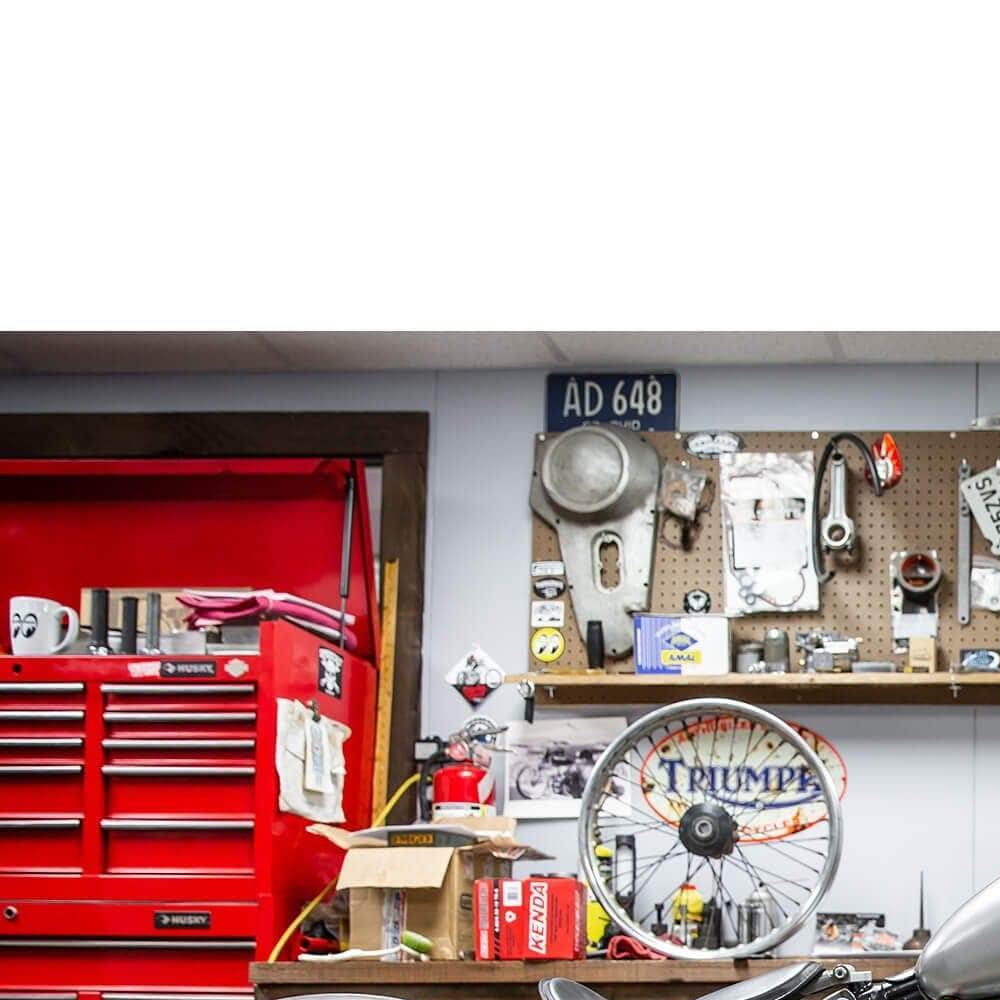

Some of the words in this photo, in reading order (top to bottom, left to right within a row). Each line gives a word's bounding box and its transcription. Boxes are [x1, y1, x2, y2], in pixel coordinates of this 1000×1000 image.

[563, 380, 604, 417] AD
[612, 379, 662, 415] 648
[177, 663, 215, 674] HUSKY
[530, 884, 546, 952] KENDA
